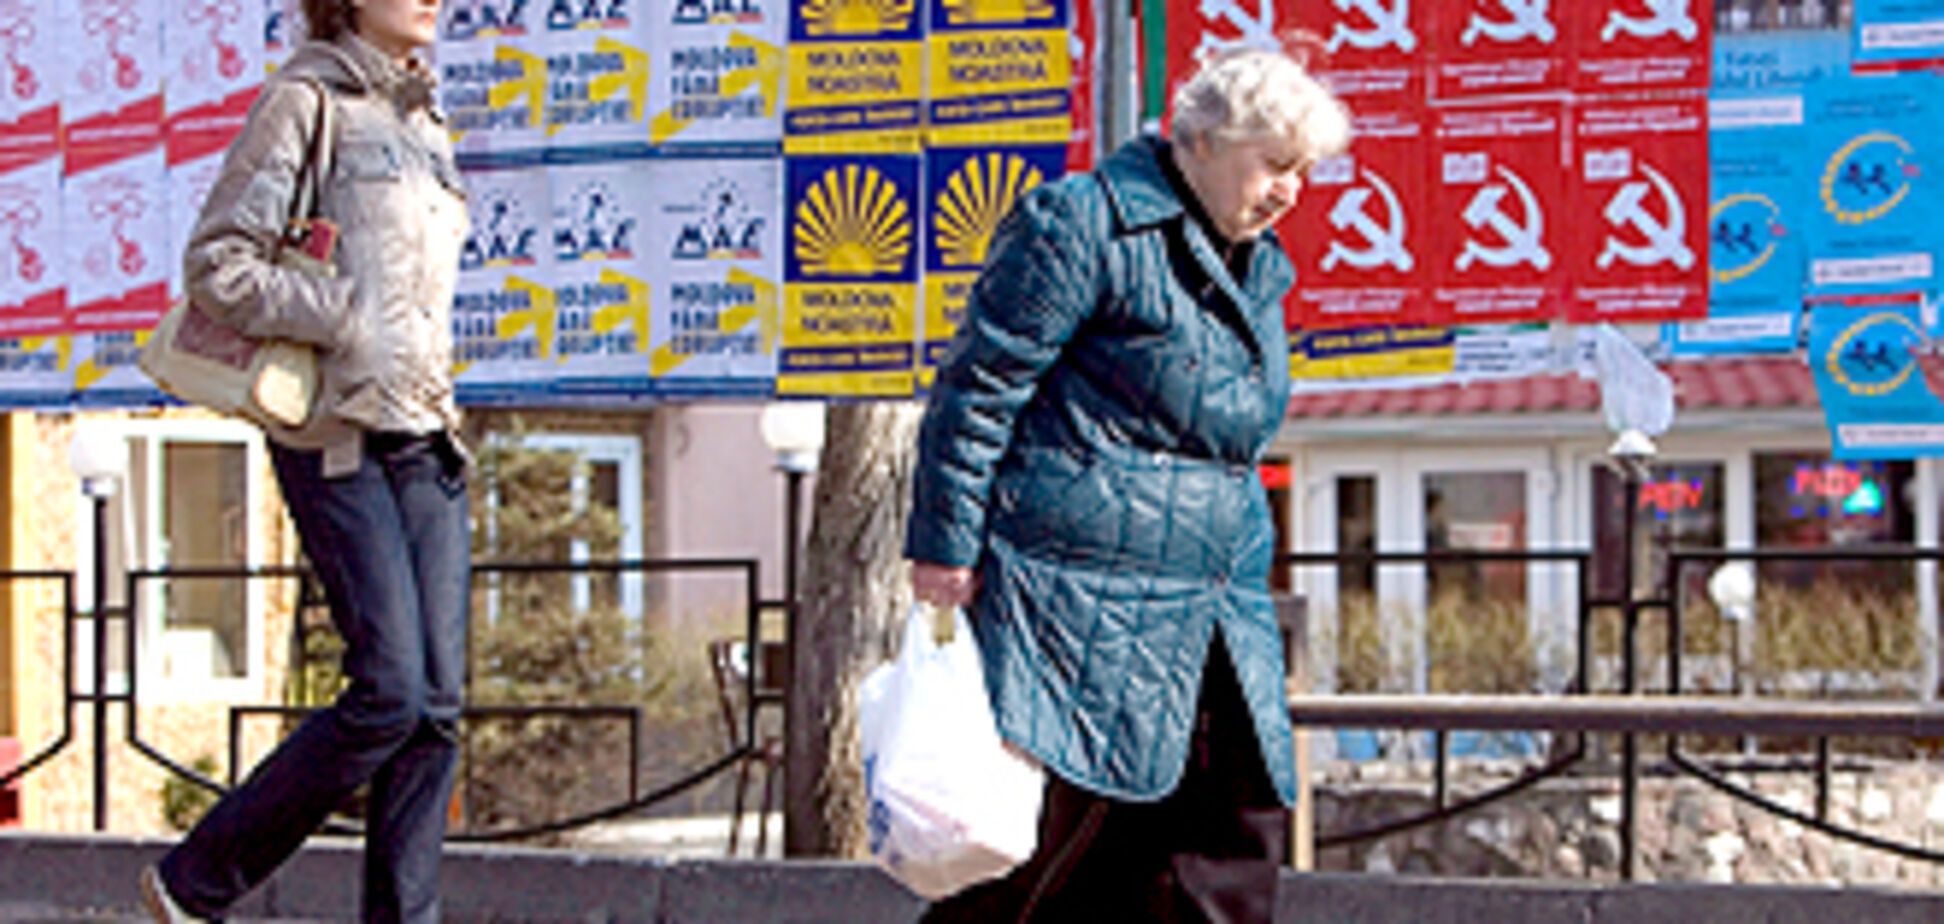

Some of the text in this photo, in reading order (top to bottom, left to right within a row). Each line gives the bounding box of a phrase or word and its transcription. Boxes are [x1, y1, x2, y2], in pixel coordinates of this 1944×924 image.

[948, 38, 1048, 57] MOLDOVA
[671, 46, 757, 71] MOLDOVA
[807, 51, 901, 67] MOLDOVA
[671, 282, 757, 304] MOLDOVA
[802, 292, 895, 308] MOLDOVA
